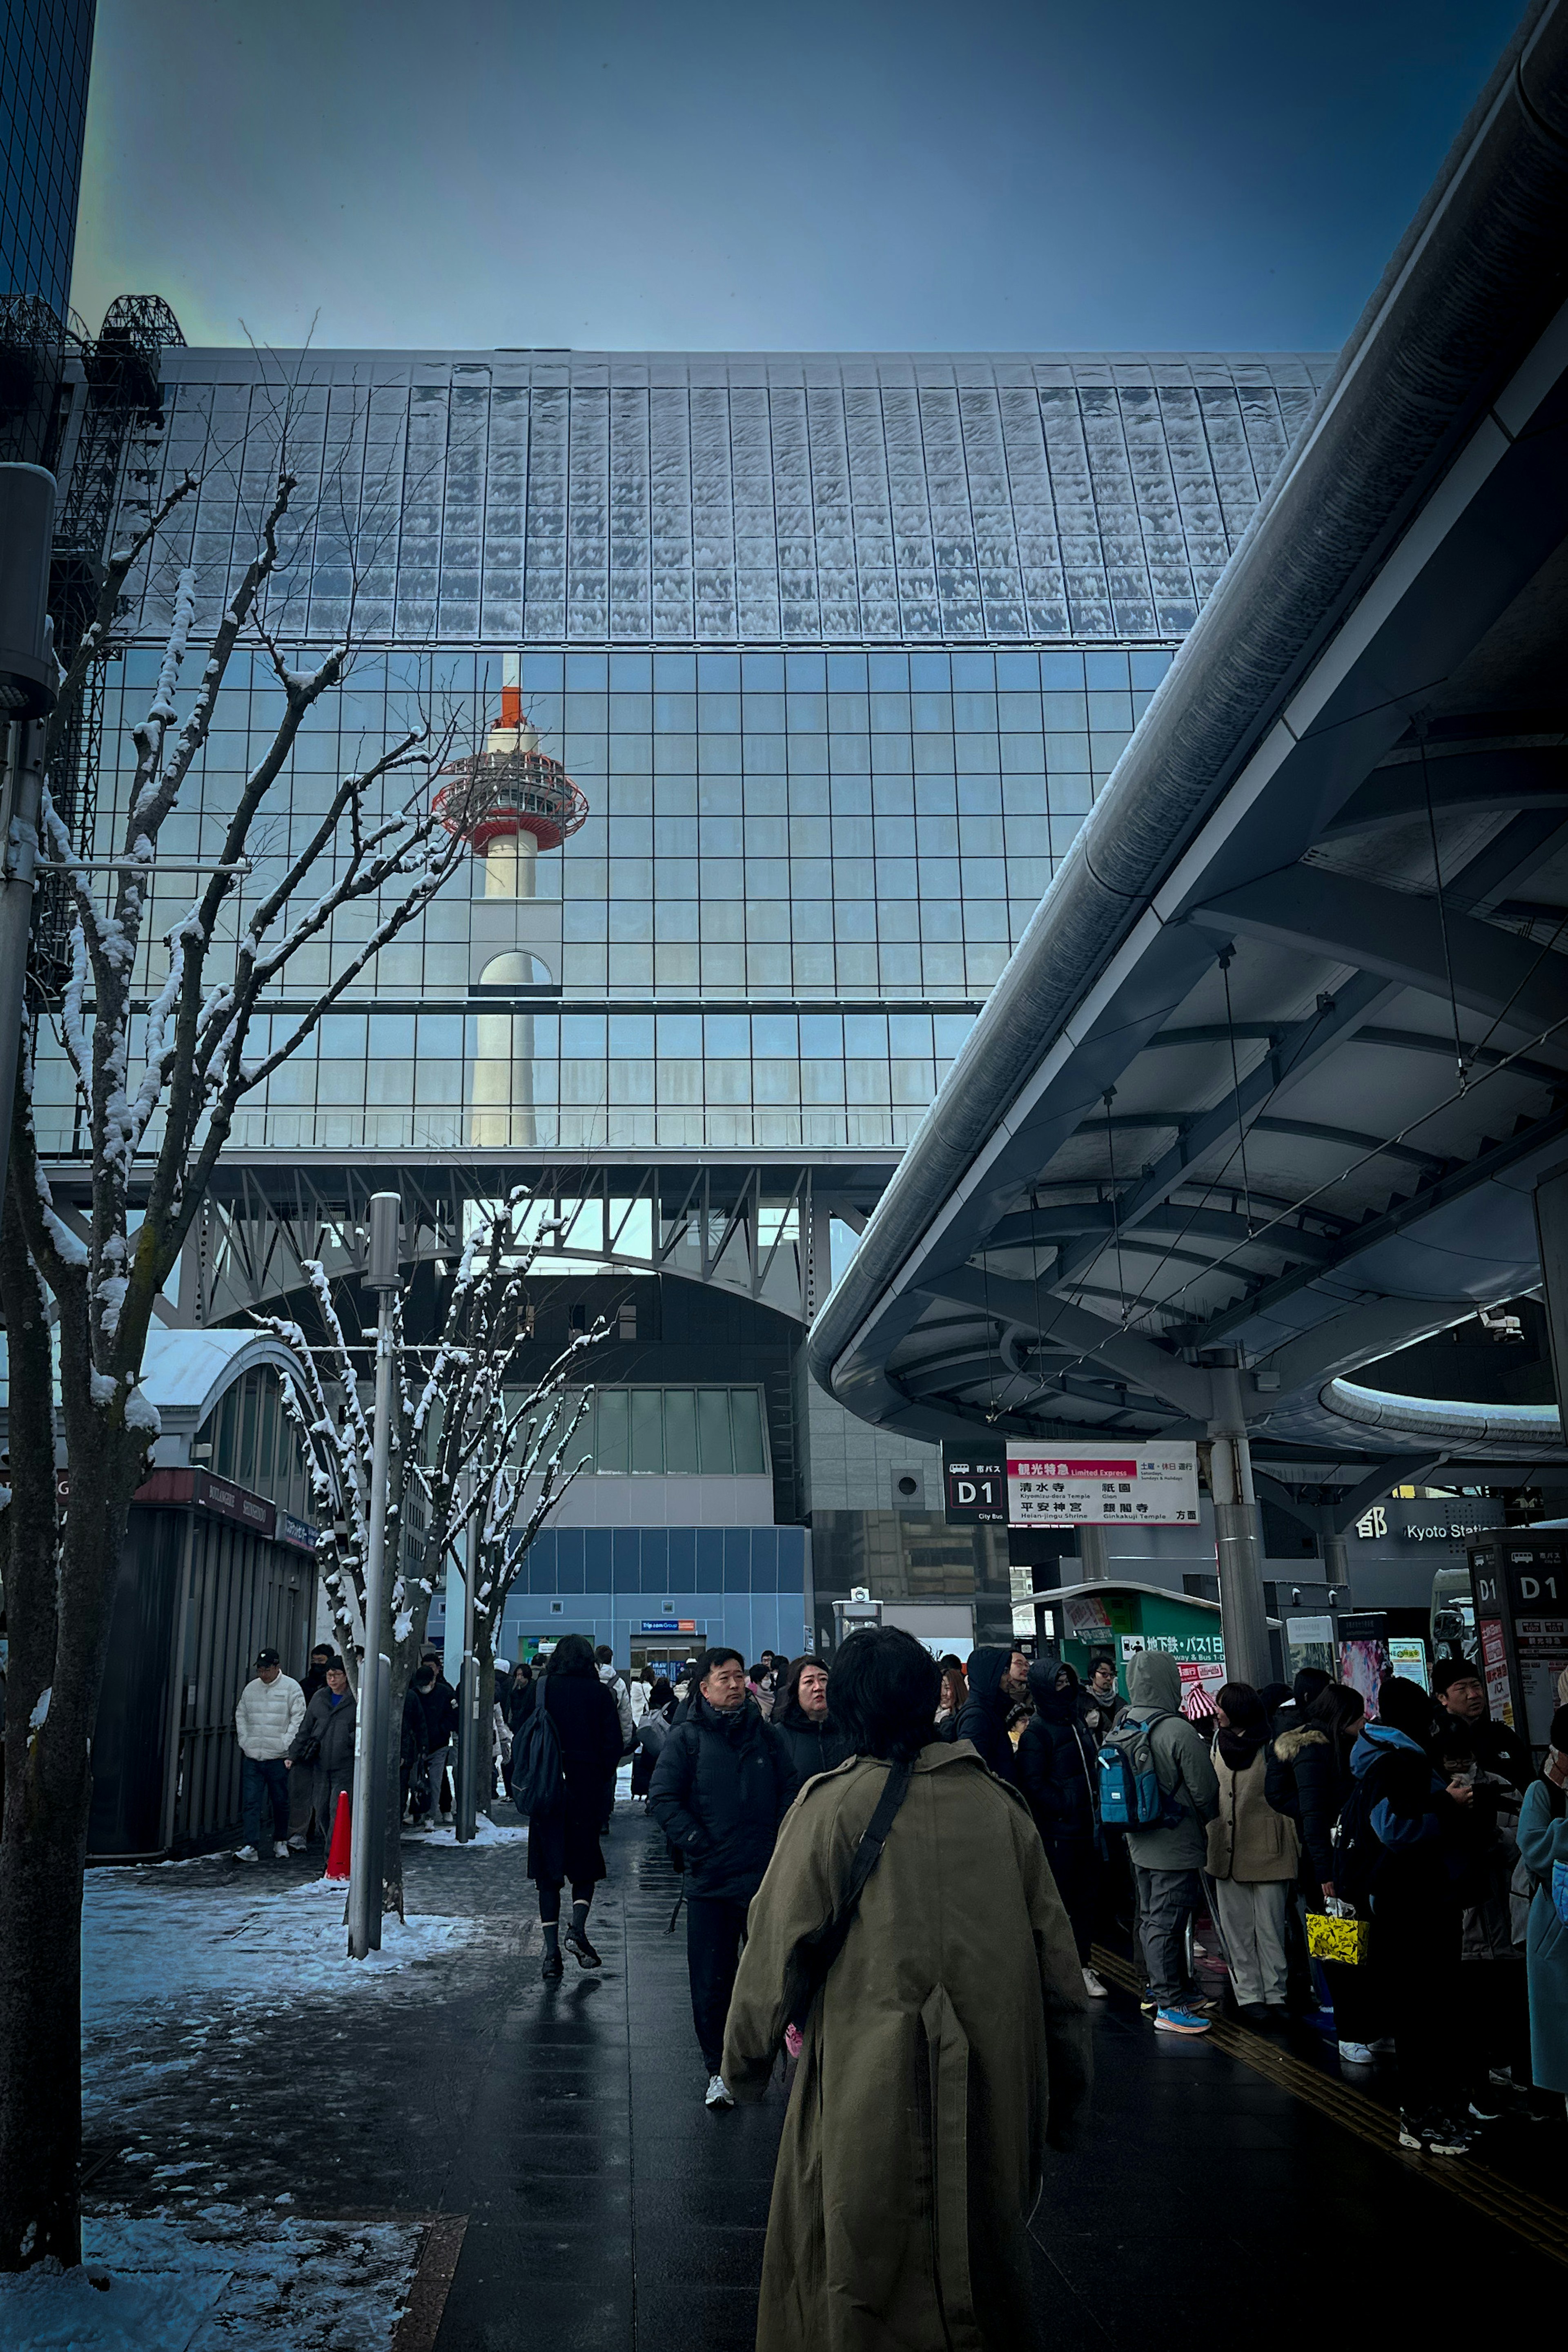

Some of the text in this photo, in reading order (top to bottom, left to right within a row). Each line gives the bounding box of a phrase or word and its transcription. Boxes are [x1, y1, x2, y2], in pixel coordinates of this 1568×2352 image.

[976, 1465, 1000, 1473] 市バス
[1018, 1463, 1069, 1476] 観光特急
[958, 1482, 992, 1503] D1
[1020, 1483, 1065, 1492] 清水寺
[1021, 1502, 1082, 1512] 平安神宮
[1103, 1503, 1148, 1512] 銀閣寺
[1176, 1511, 1196, 1520] 方面
[1407, 1525, 1447, 1541] Kyoto
[1479, 1578, 1497, 1601] D1
[1520, 1577, 1557, 1598] D1
